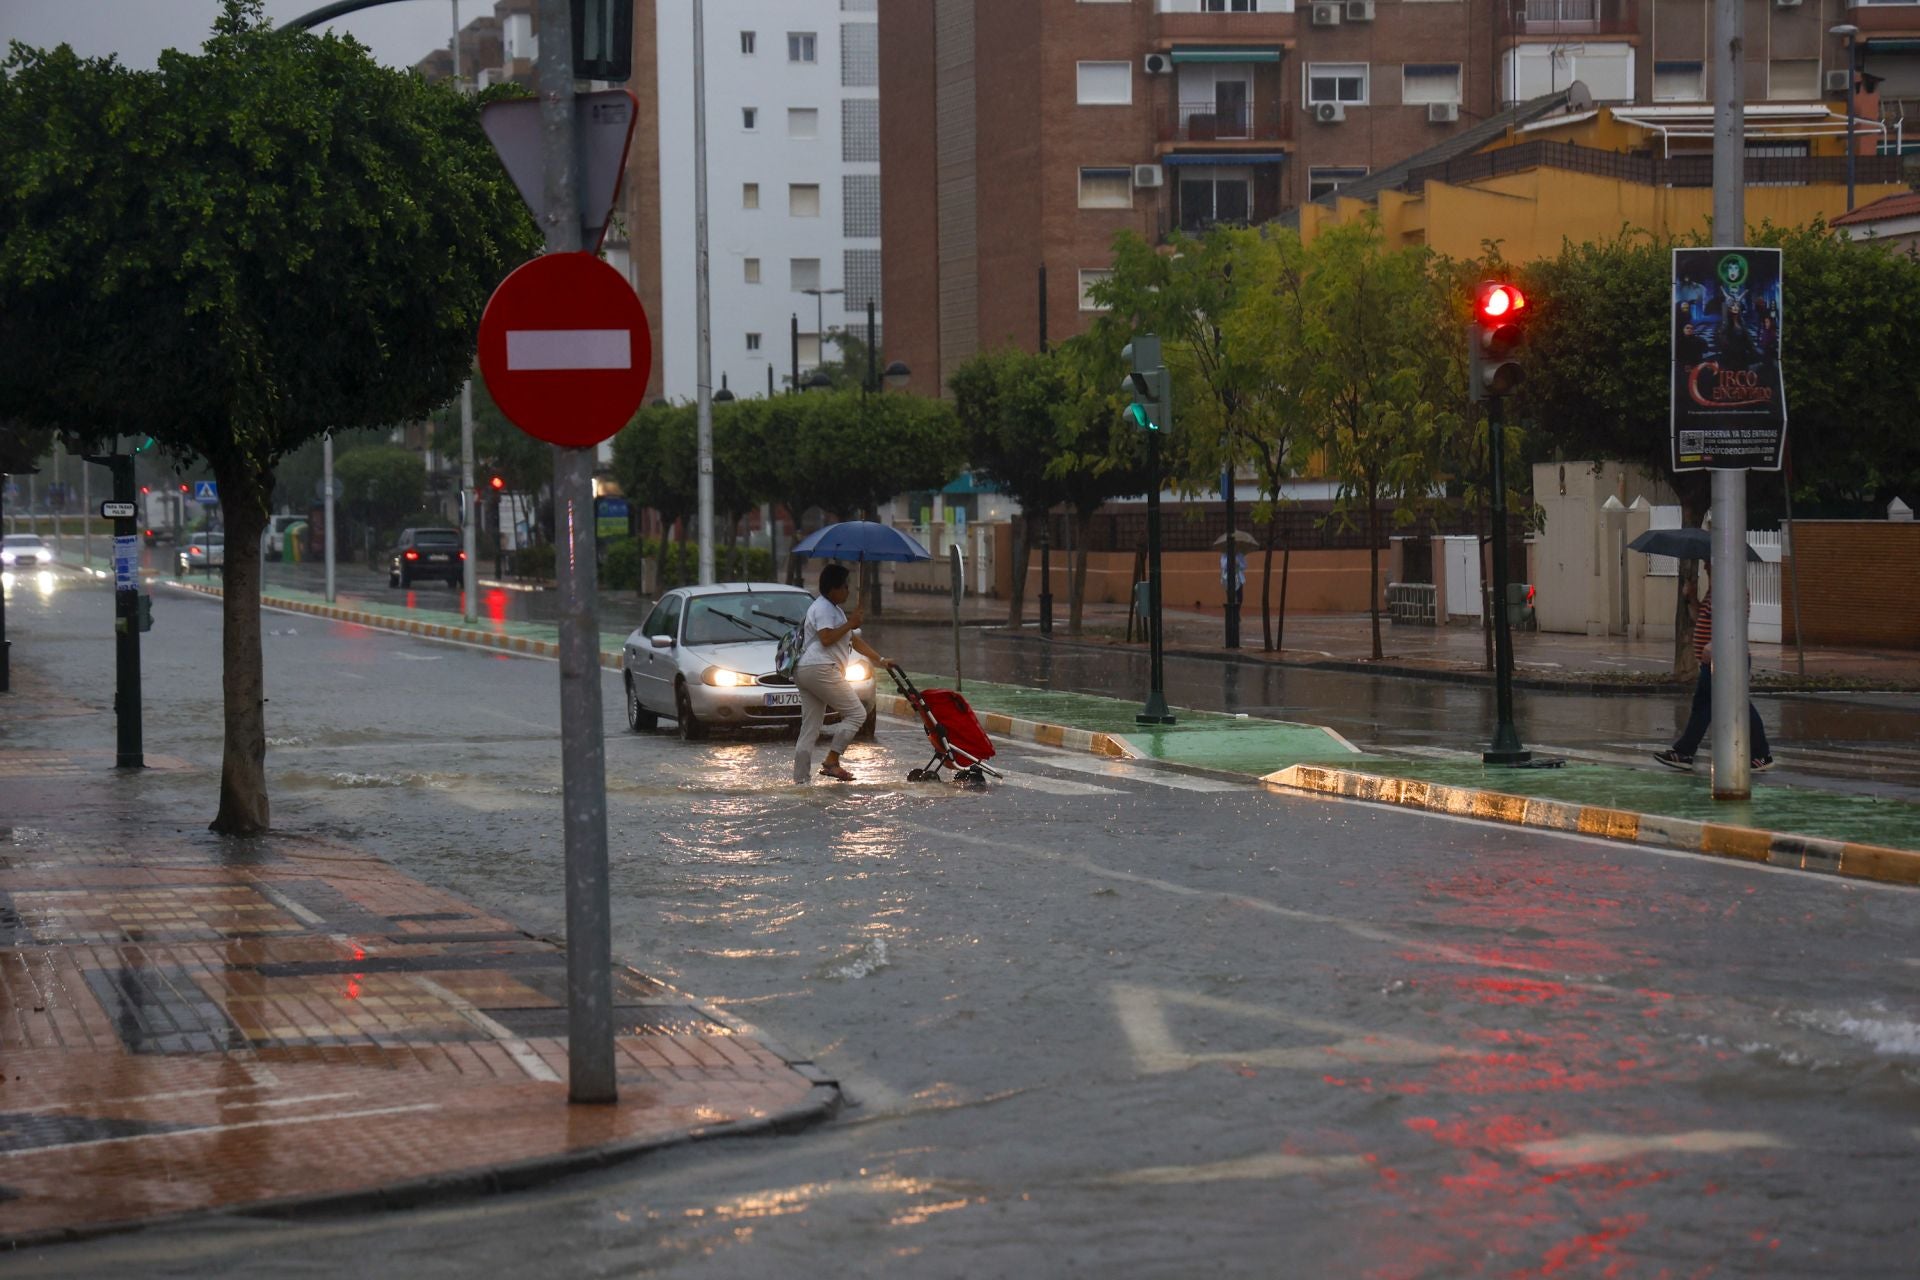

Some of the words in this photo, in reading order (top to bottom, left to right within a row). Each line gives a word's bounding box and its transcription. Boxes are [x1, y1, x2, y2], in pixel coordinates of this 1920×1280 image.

[1704, 430, 1730, 438] RESERVA
[1731, 430, 1740, 438] YA
[1740, 430, 1751, 438] TUS
[772, 695, 785, 704] MU
